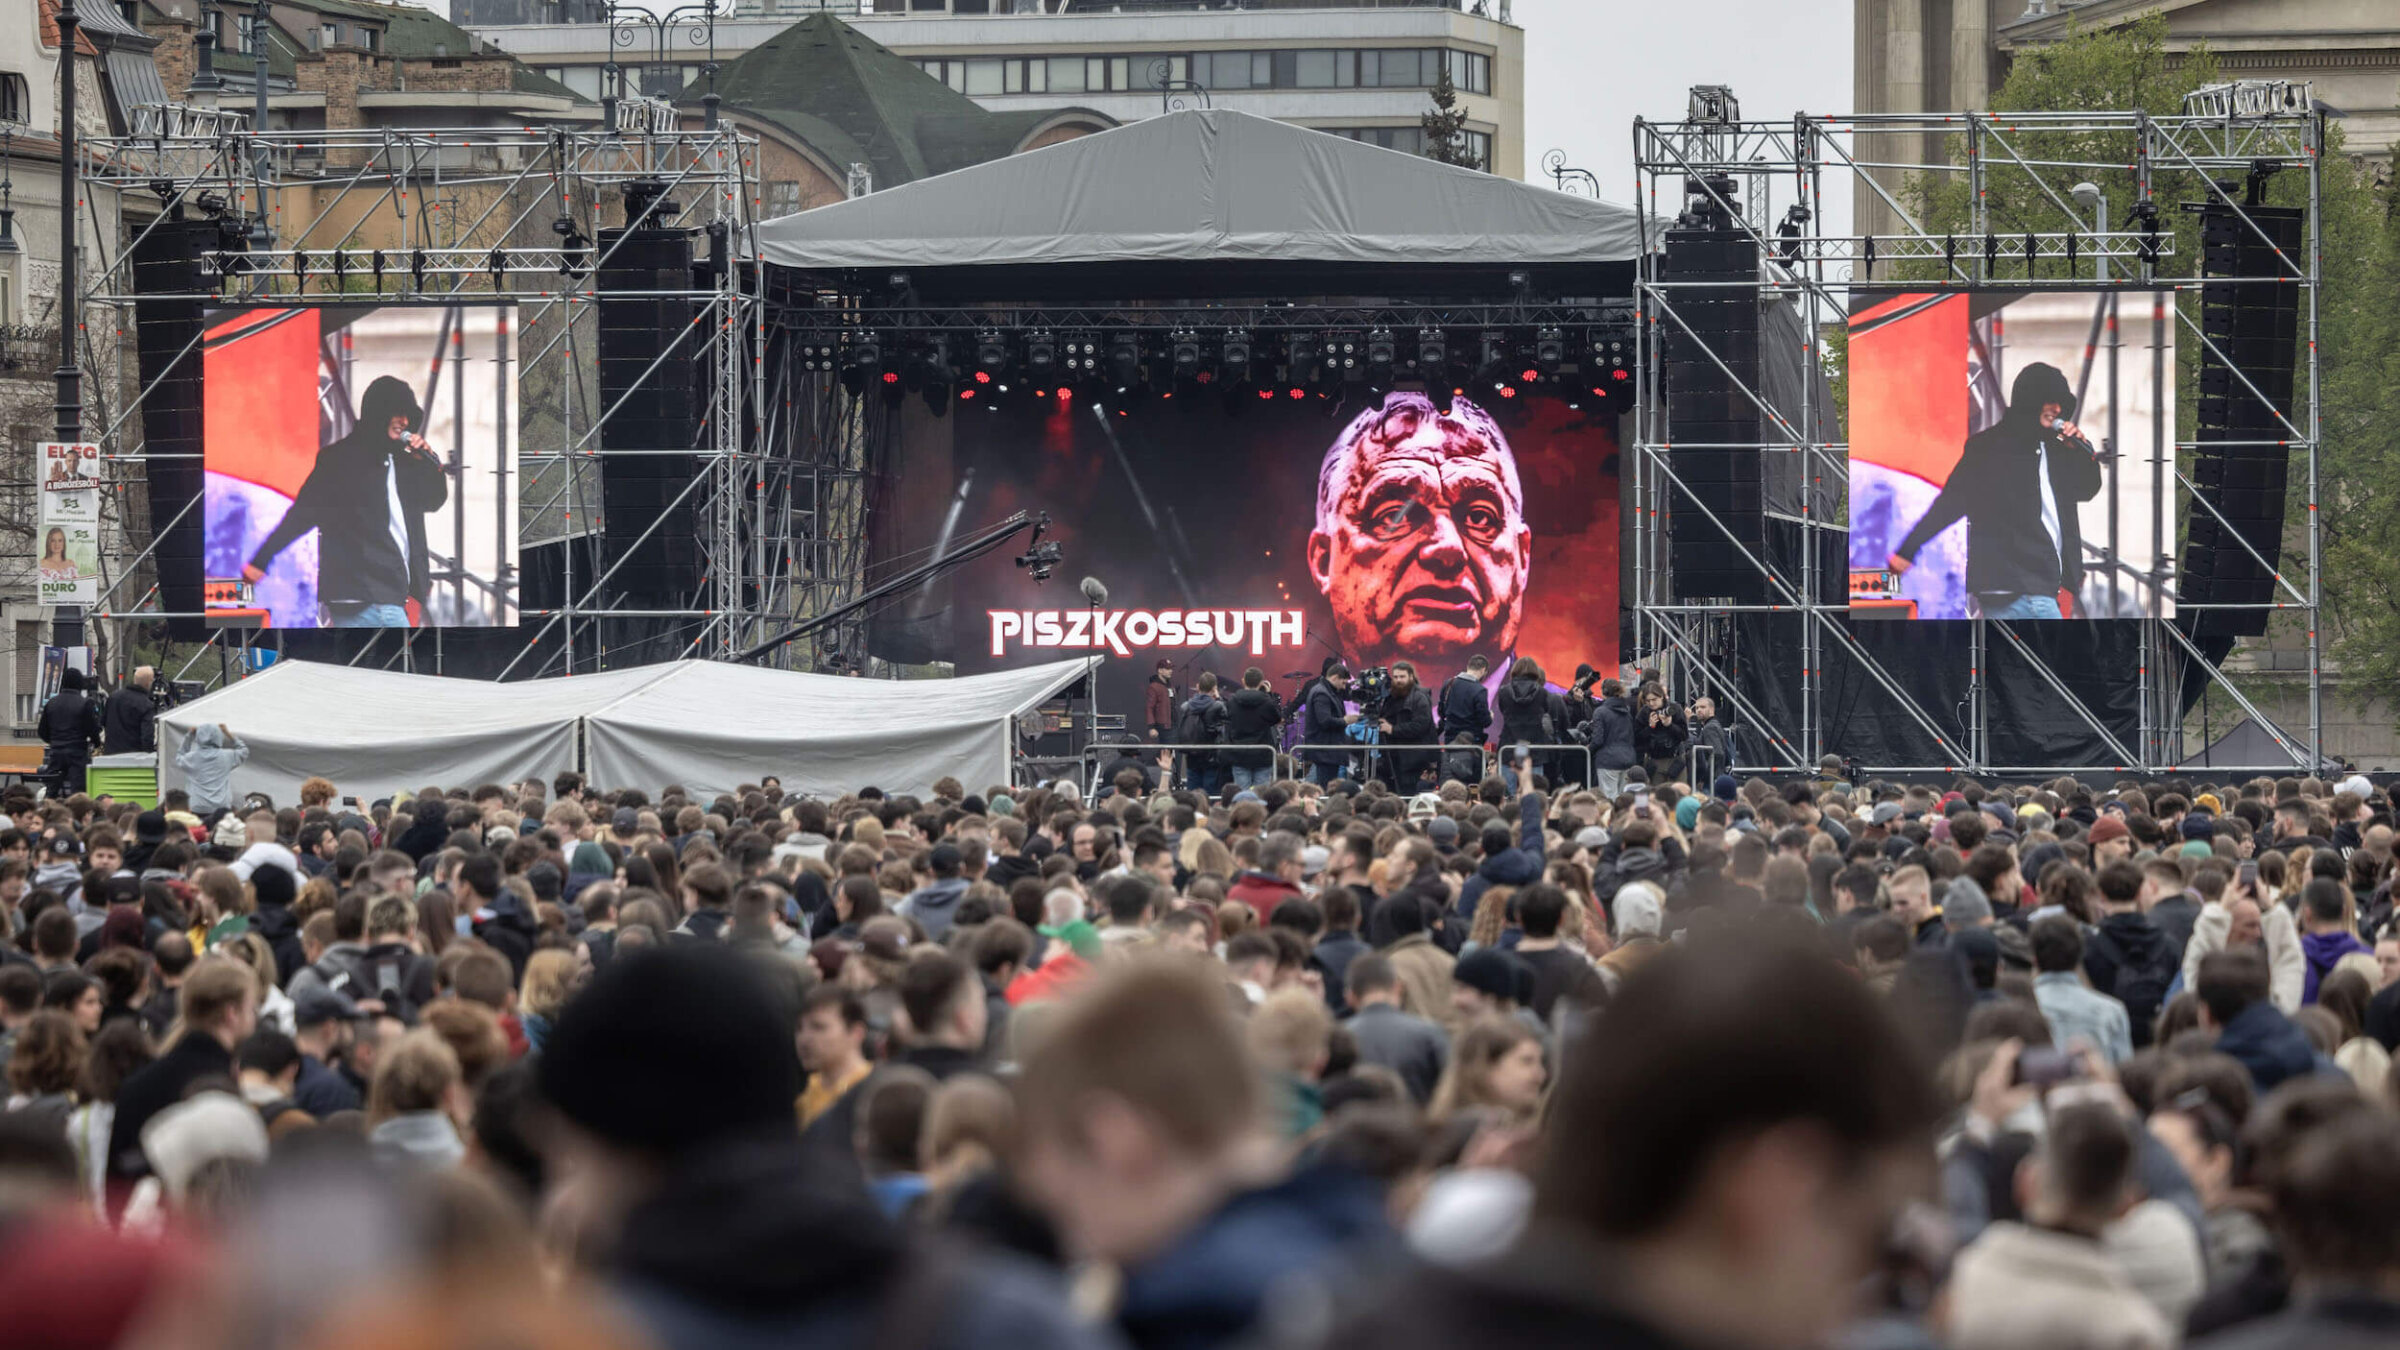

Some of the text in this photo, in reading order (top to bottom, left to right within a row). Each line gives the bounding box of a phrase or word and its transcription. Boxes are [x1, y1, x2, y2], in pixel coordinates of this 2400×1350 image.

[47, 443, 97, 460] ELÉG
[46, 481, 53, 490] A
[987, 608, 1305, 657] PISZKOSSUTH
